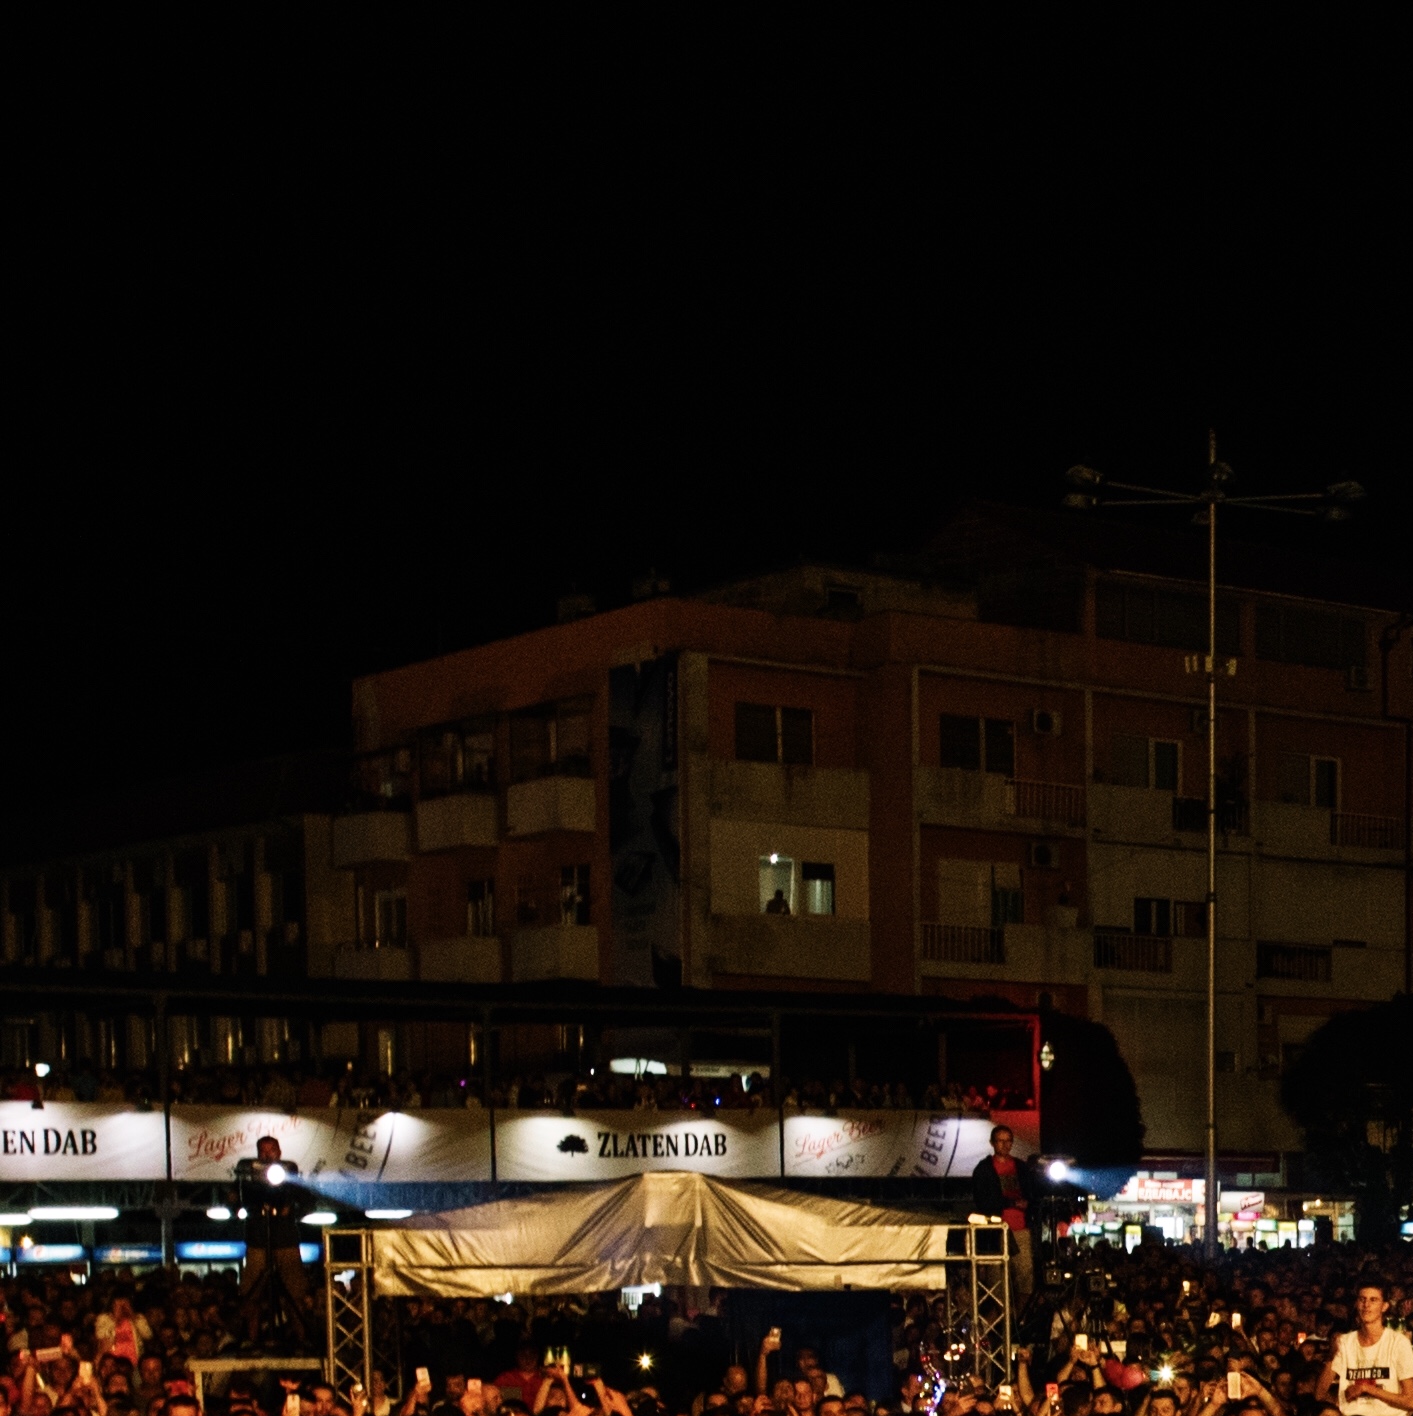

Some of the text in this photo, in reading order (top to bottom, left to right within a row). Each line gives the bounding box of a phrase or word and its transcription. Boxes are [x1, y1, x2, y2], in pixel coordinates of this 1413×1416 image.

[43, 1128, 97, 1156] DAB
[187, 1127, 247, 1162] Lager
[597, 1131, 728, 1159] ZLATEN DAB
[795, 1131, 843, 1161] Lager
